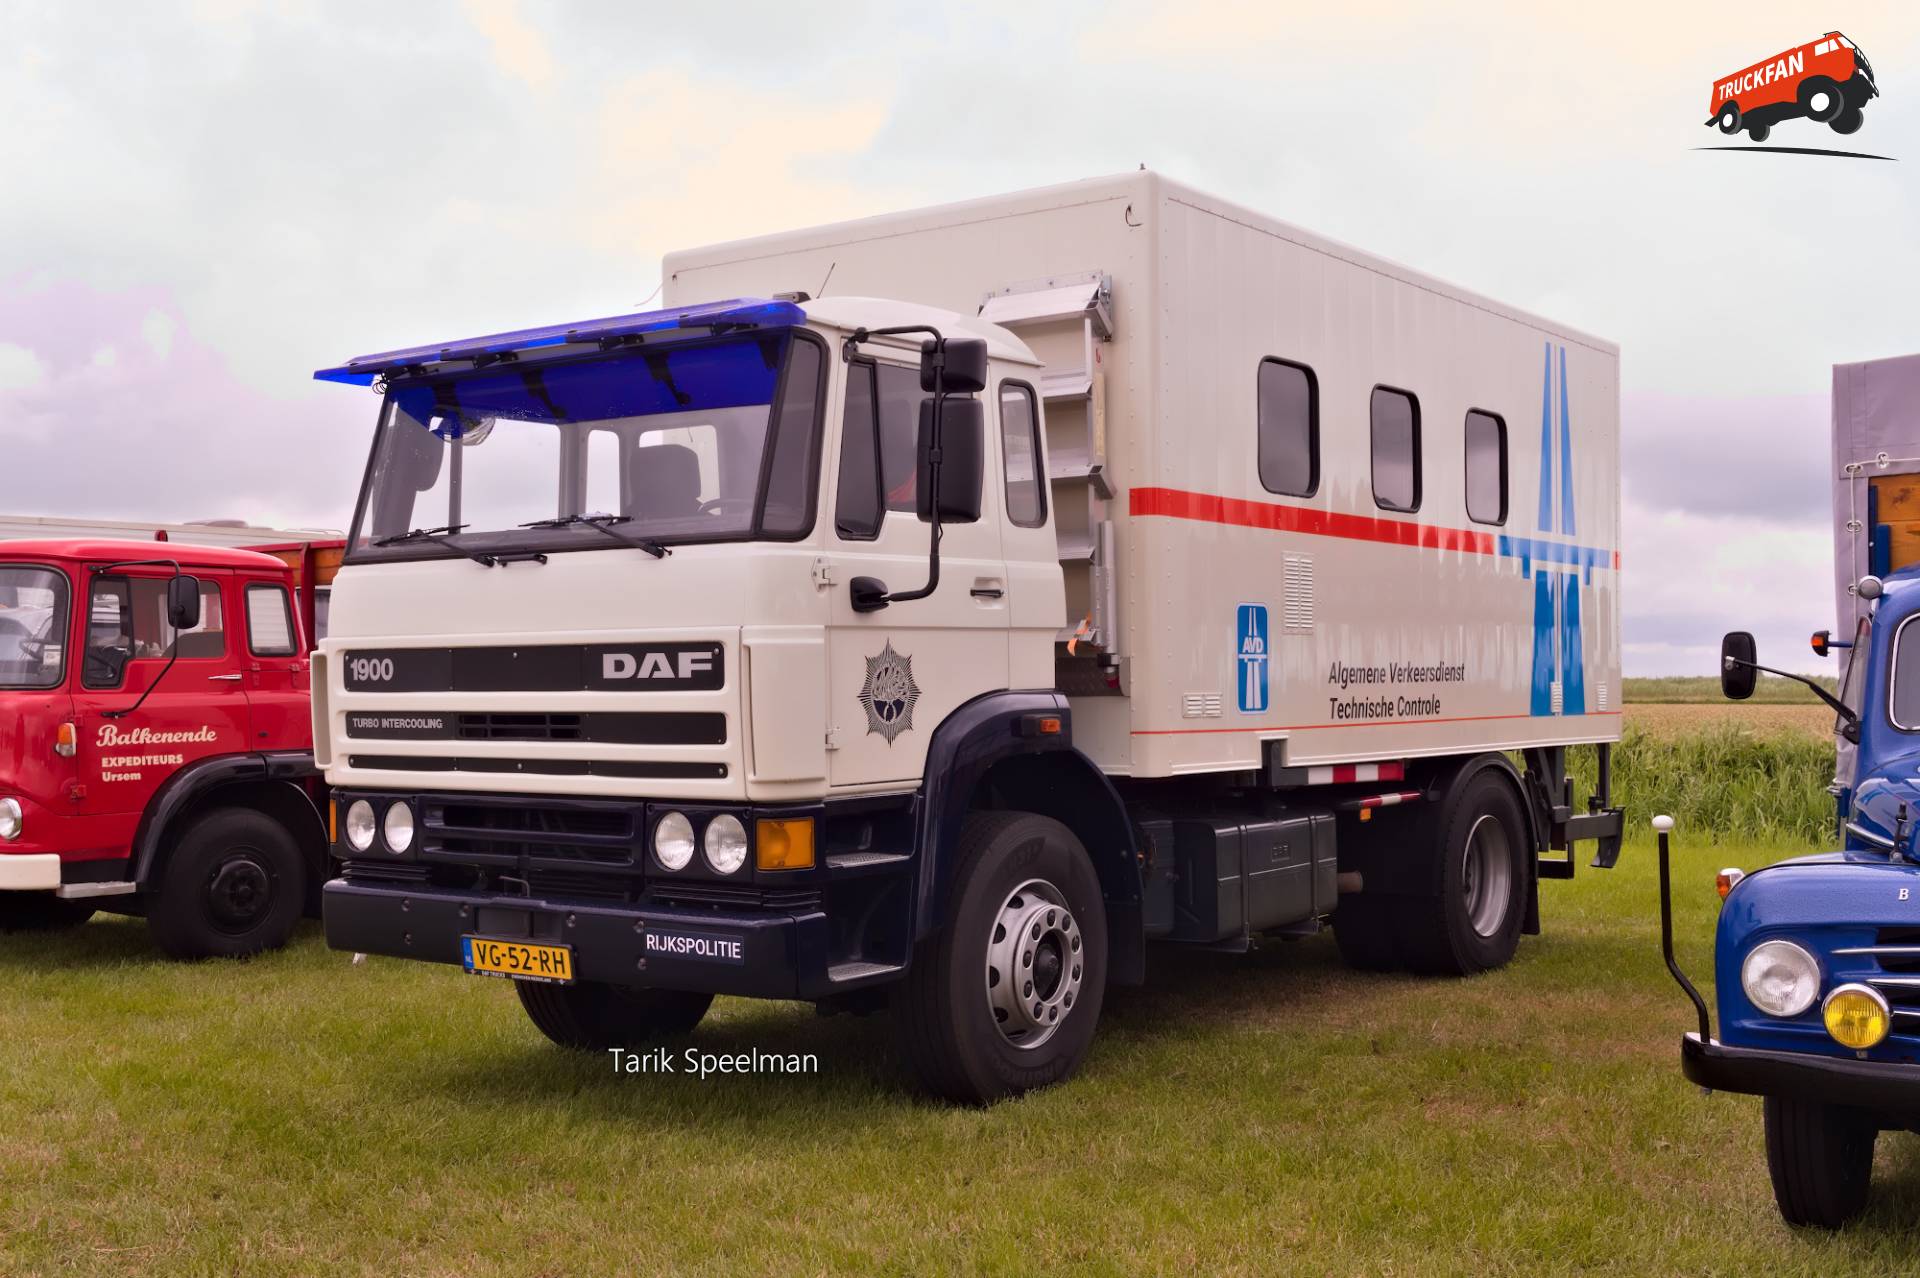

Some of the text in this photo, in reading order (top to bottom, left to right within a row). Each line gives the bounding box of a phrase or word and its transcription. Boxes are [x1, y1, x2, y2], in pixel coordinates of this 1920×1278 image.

[1242, 637, 1264, 654] AVD
[350, 658, 394, 681] 1900
[602, 652, 713, 679] DAF
[1328, 661, 1465, 689] Algemene Verkeersdienst
[1330, 694, 1441, 719] Technische Controle
[352, 718, 443, 729] TURBO INTERCOOLING
[96, 724, 218, 747] Balkenende
[101, 754, 183, 768] EXPEDITEURS
[102, 771, 141, 782] Ursem
[1898, 888, 1909, 900] B
[646, 934, 741, 959] RIJKSPOLITIE
[476, 943, 566, 974] VG-52-RH
